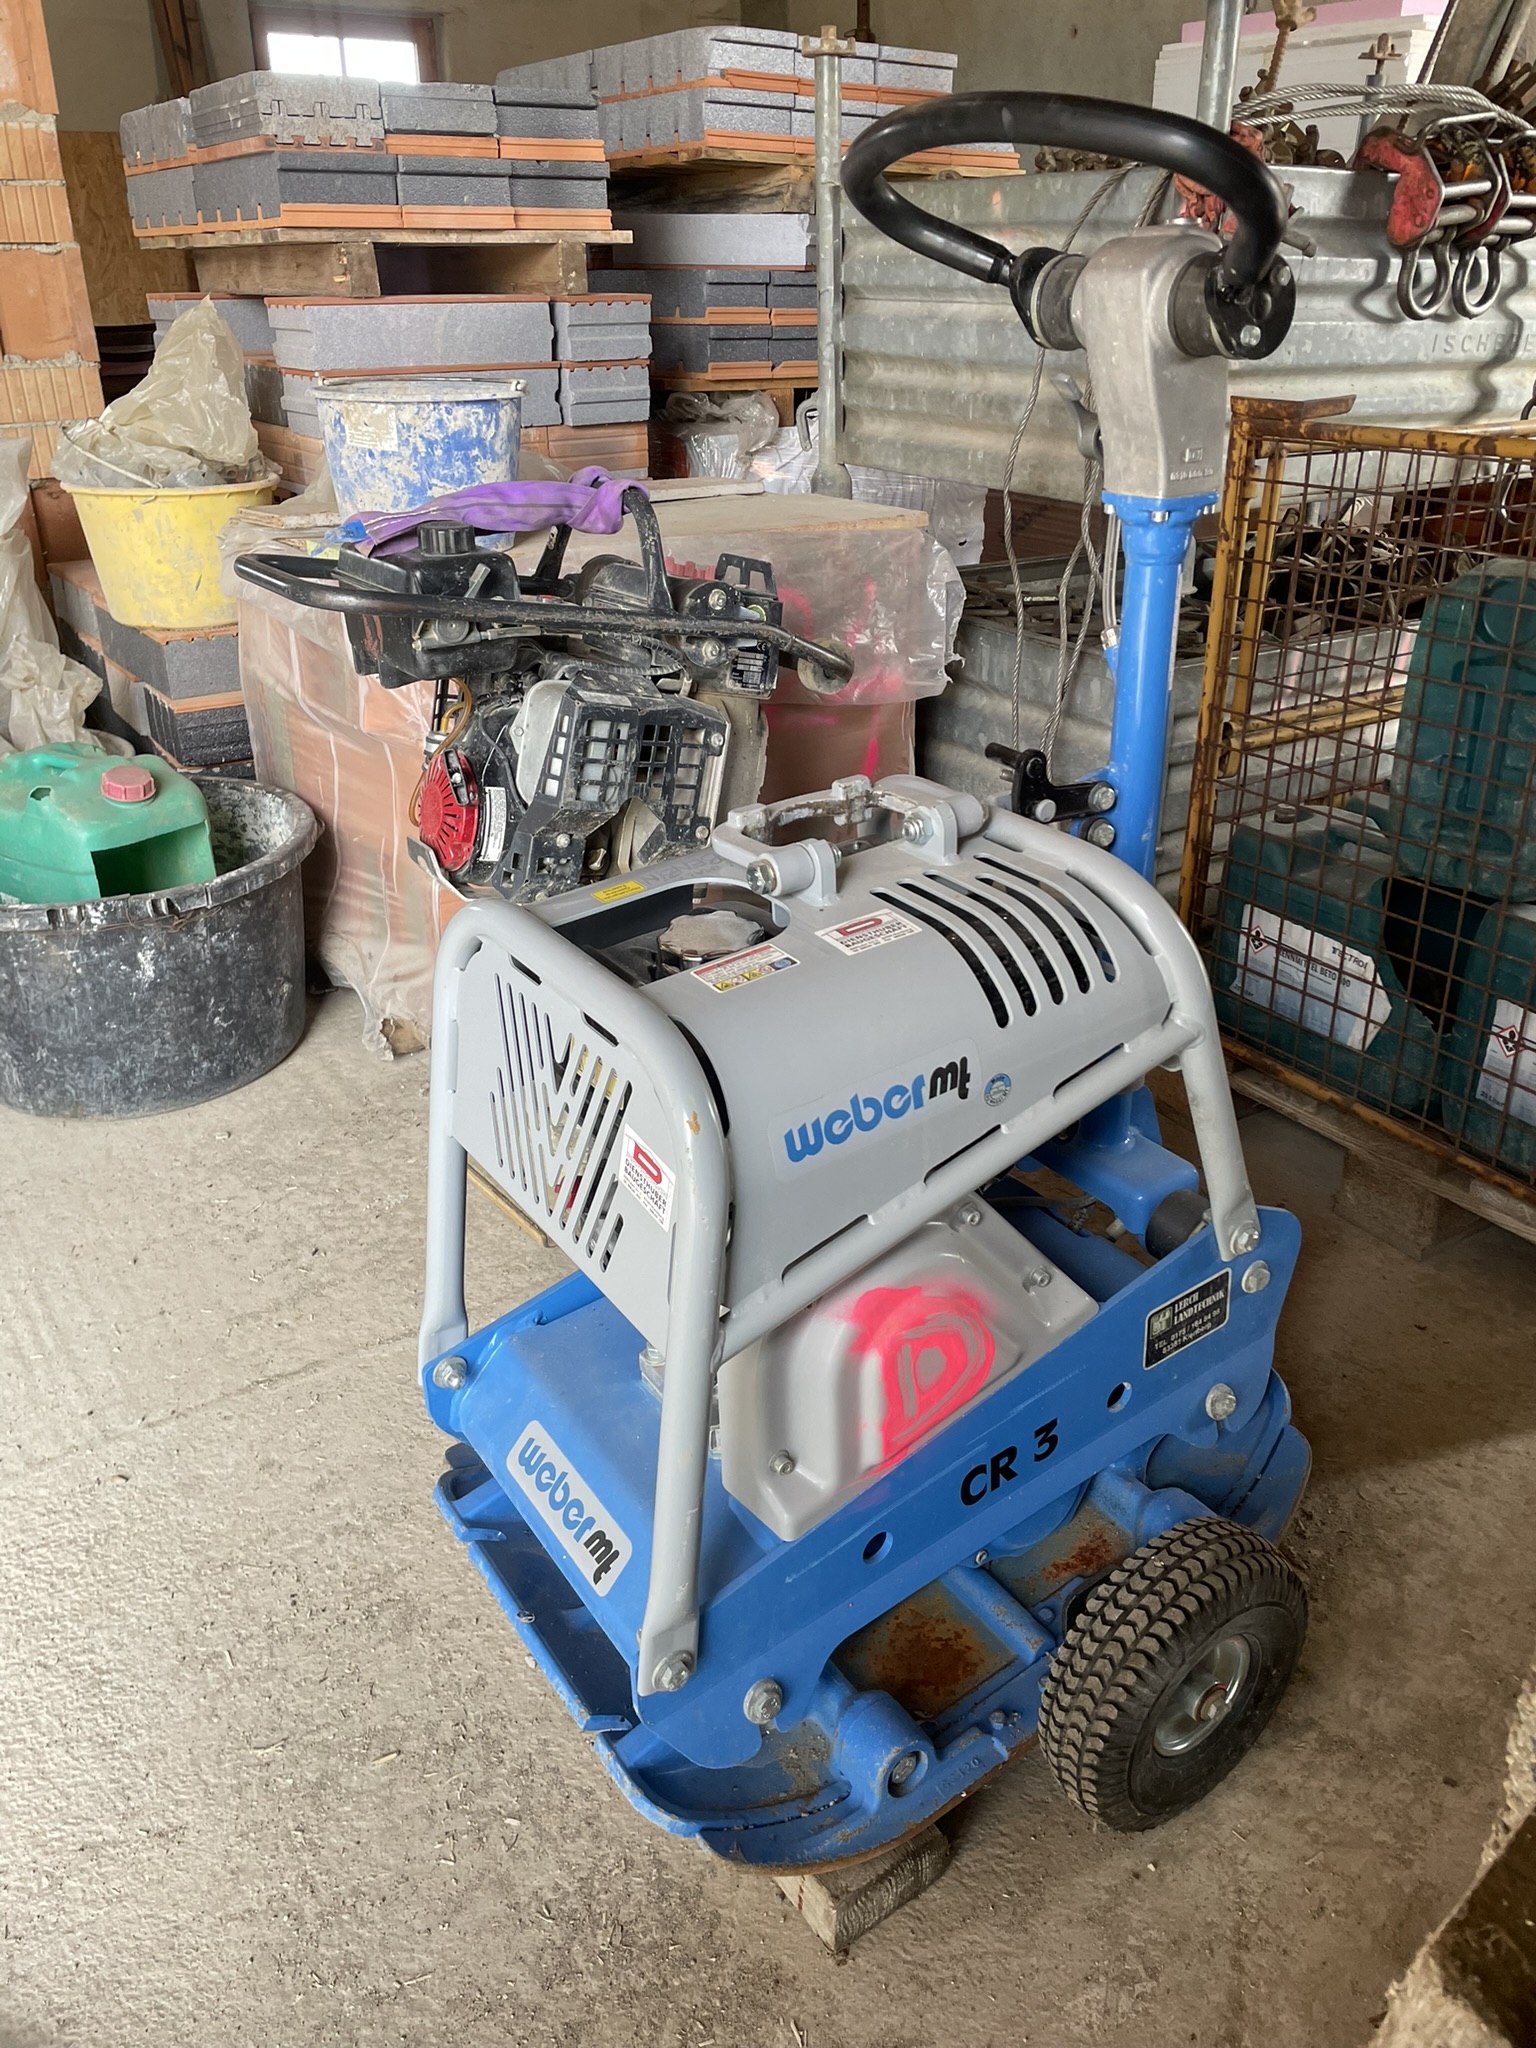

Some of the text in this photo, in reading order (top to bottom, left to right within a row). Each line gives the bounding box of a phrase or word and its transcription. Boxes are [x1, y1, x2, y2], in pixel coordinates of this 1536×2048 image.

[625, 1158, 667, 1207] DIENSTHUBER
[1174, 1291, 1199, 1314] LERCH
[1174, 1289, 1225, 1325] LANDTECHNIK
[960, 1417, 1059, 1506] CR 3
